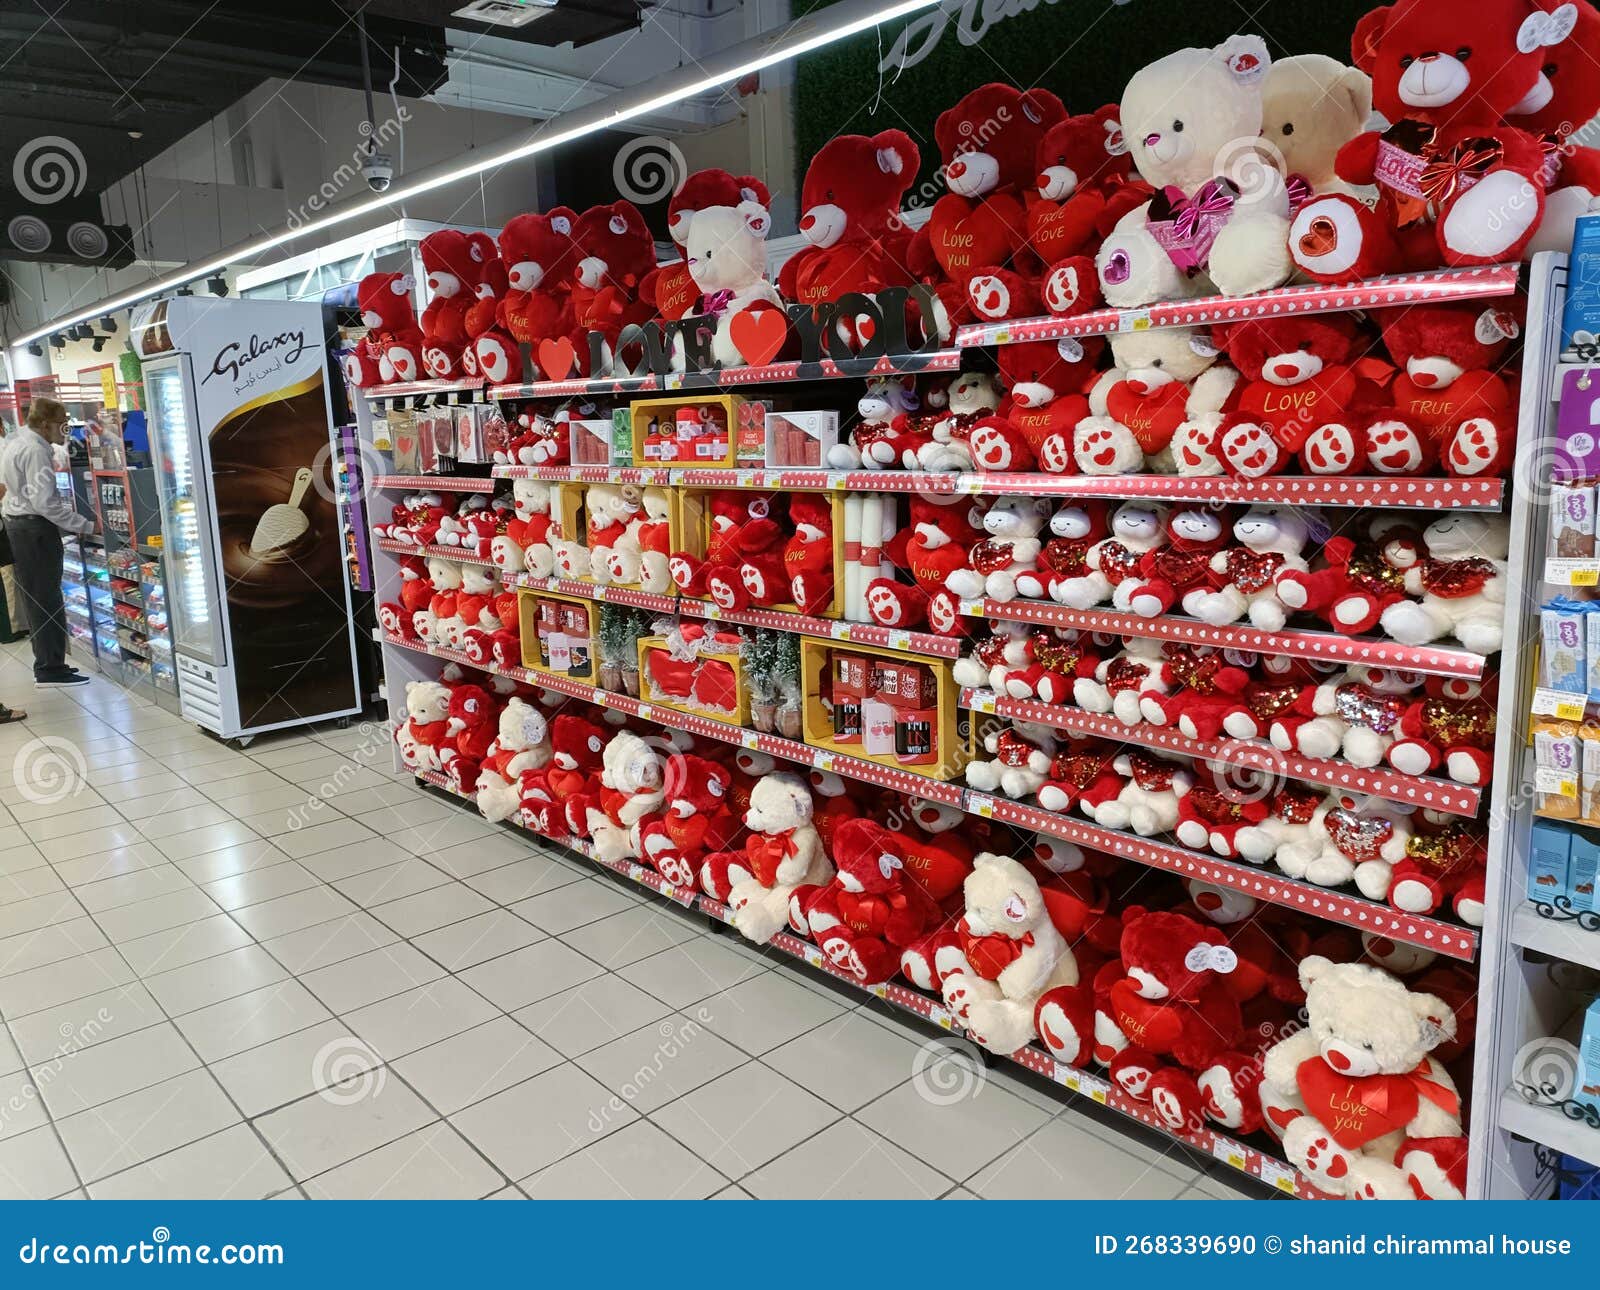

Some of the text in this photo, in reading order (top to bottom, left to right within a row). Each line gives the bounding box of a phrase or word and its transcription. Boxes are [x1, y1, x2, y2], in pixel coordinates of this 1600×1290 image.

[1379, 155, 1421, 187] LOVE
[943, 229, 974, 247] Love
[1036, 226, 1065, 243] LOVE
[947, 254, 970, 270] you
[663, 291, 687, 311] LOVE
[787, 283, 940, 378] YOU
[201, 331, 320, 385] Galaxy
[1263, 391, 1317, 413] Love
[1410, 400, 1454, 415] TRUE
[1020, 415, 1052, 427] TRUE
[1124, 413, 1152, 429] Love
[1136, 433, 1152, 442] ou
[913, 561, 941, 580] Love
[905, 855, 932, 870] RUE
[1120, 1012, 1147, 1037] TRUE
[1329, 1094, 1368, 1117] Love
[1334, 1114, 1363, 1132] you
